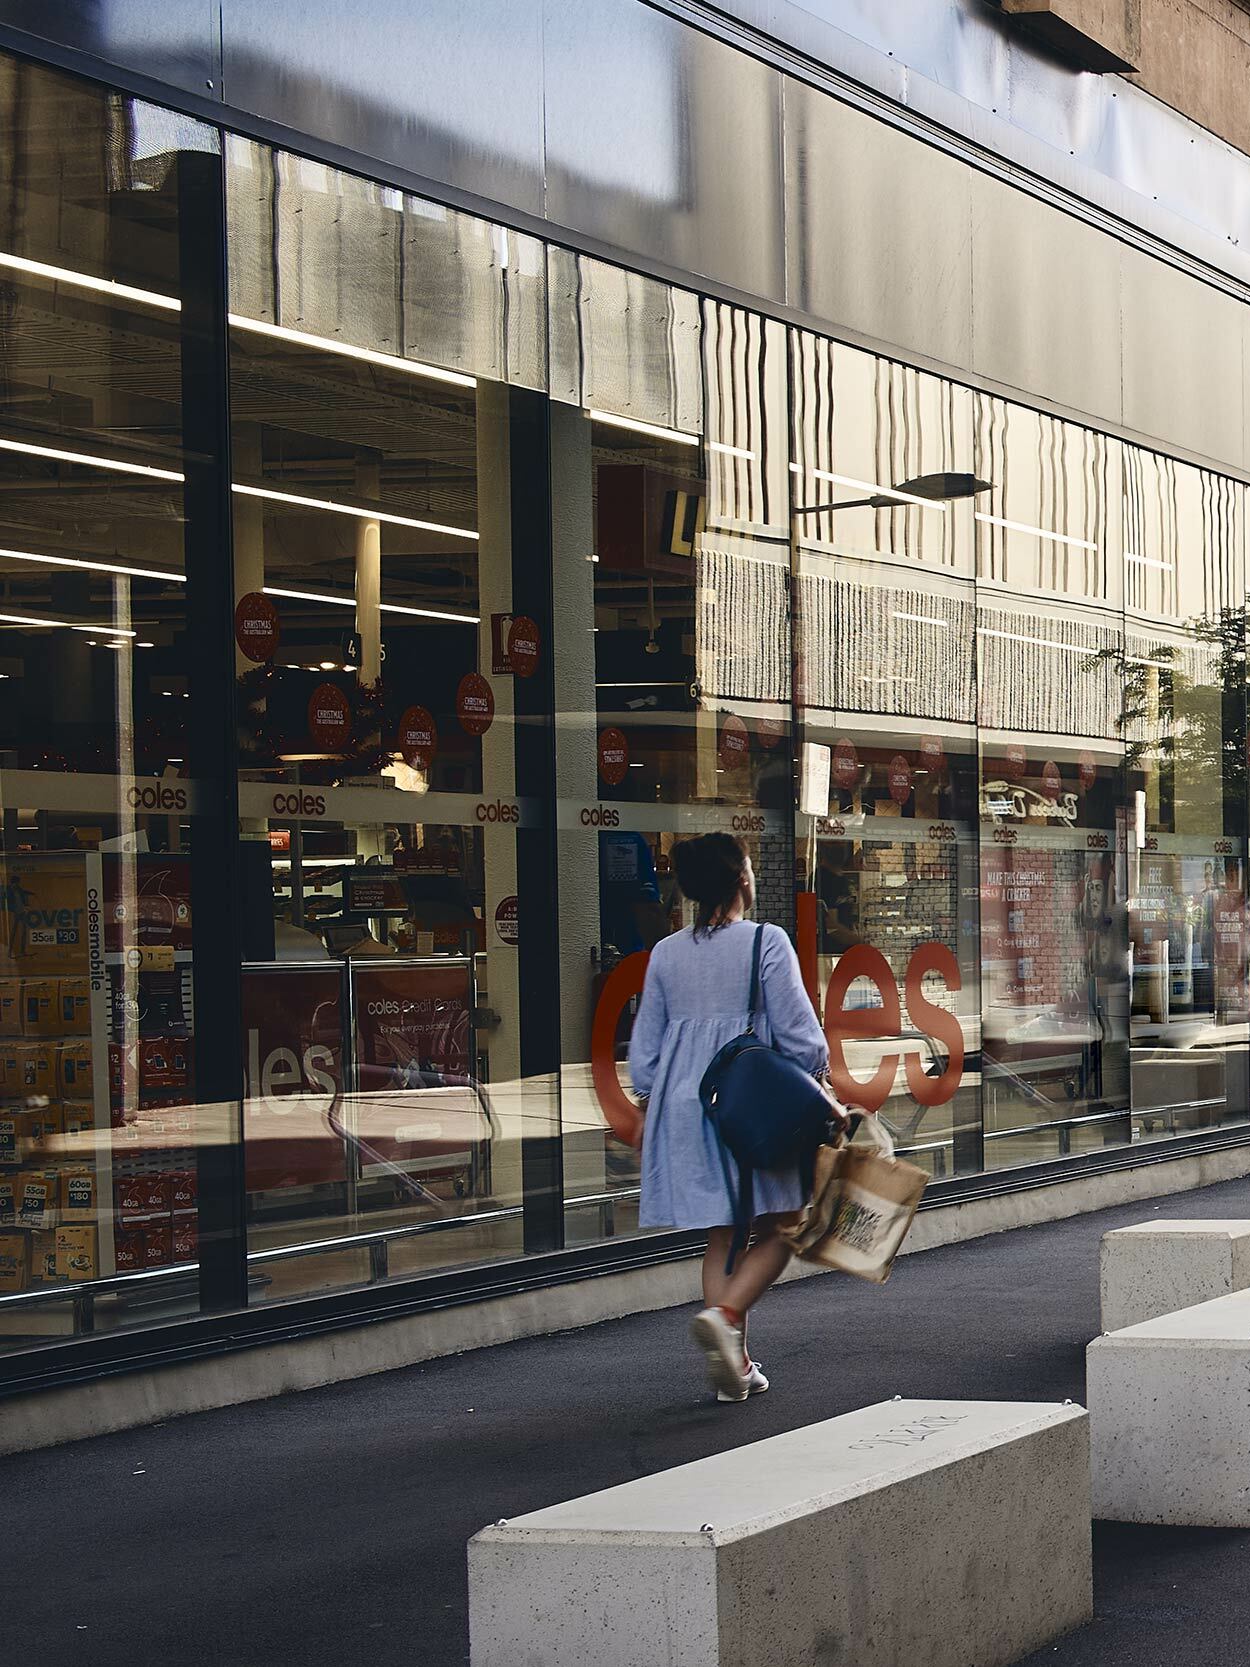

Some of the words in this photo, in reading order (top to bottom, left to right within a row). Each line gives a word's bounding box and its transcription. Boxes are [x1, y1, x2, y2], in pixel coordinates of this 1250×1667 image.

[243, 619, 272, 630] CHRISTMAS
[347, 639, 356, 658] 4
[379, 643, 387, 661] 5
[689, 682, 697, 698] 6
[464, 696, 488, 707] CHRISTMAS
[317, 709, 344, 719] CHRISTMAS
[407, 731, 431, 741] CHRISTMAS
[127, 782, 187, 810] coles
[273, 789, 326, 816] coles
[476, 799, 520, 823] coles
[580, 804, 620, 827] coles
[732, 811, 765, 832] coles
[929, 822, 956, 841] coles
[993, 825, 1018, 844] coles
[1086, 831, 1109, 849] coles
[1214, 840, 1232, 854] coles
[987, 872, 1003, 886] MAKE
[1003, 872, 1016, 885] THIS
[1016, 871, 1046, 886] CHRISTMAS
[1001, 888, 1005, 903] A
[27, 907, 83, 928] over
[32, 933, 55, 943] 35GB
[58, 931, 77, 942] $30
[88, 888, 105, 991] colesmobile
[368, 998, 399, 1016] coles
[401, 998, 431, 1013] Credit
[434, 997, 462, 1011] Cards
[592, 892, 964, 1147] cles
[243, 1028, 337, 1115] les
[25, 1186, 45, 1195] 55GB
[69, 1180, 91, 1189] 60GB
[25, 1199, 39, 1208] $50
[70, 1191, 89, 1201] $180
[123, 1198, 139, 1208] 40GB
[149, 1195, 162, 1205] 40GB
[175, 1191, 190, 1201] 40GB
[147, 1248, 162, 1258] 50GB
[175, 1243, 190, 1253] 50GB
[117, 1252, 134, 1261] 50GB
